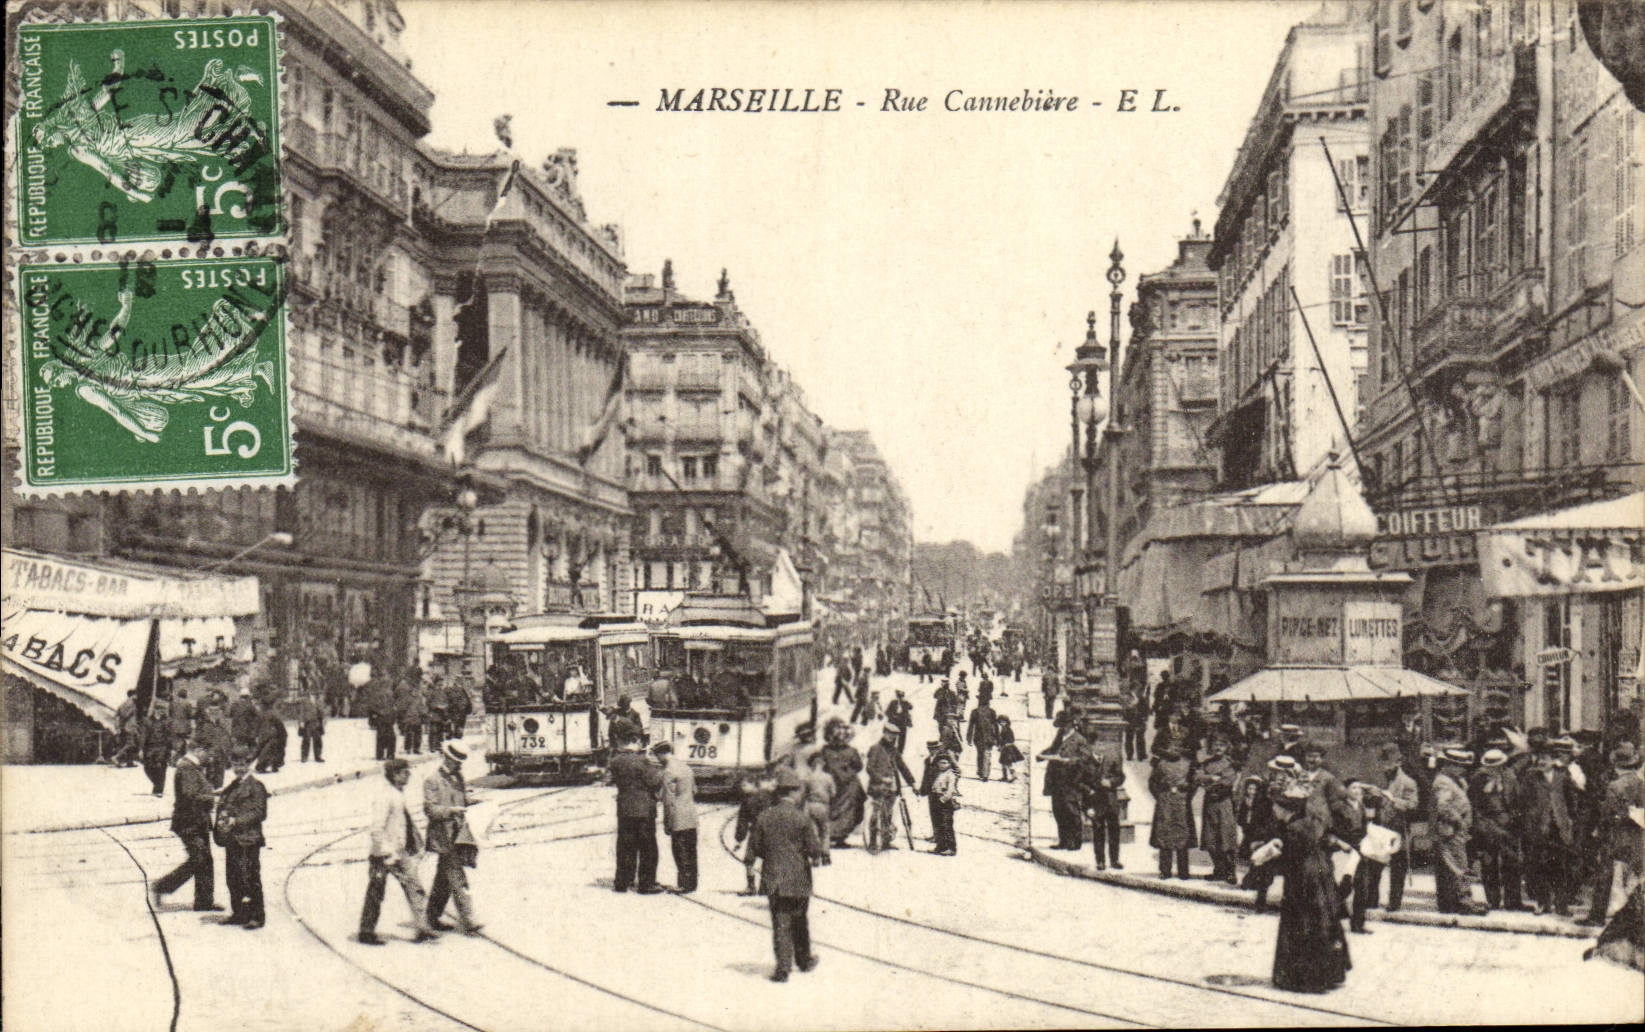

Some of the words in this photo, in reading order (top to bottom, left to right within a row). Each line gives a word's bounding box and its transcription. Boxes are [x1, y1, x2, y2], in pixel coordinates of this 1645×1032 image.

[175, 29, 258, 50] POSTES
[27, 146, 48, 238] REPUBLIQUE
[34, 386, 55, 478] REPUBLIQUE
[1375, 505, 1481, 537] COIFFEUR
[1, 630, 122, 685] ABACS
[520, 736, 546, 749] 732
[688, 744, 718, 759] 708
